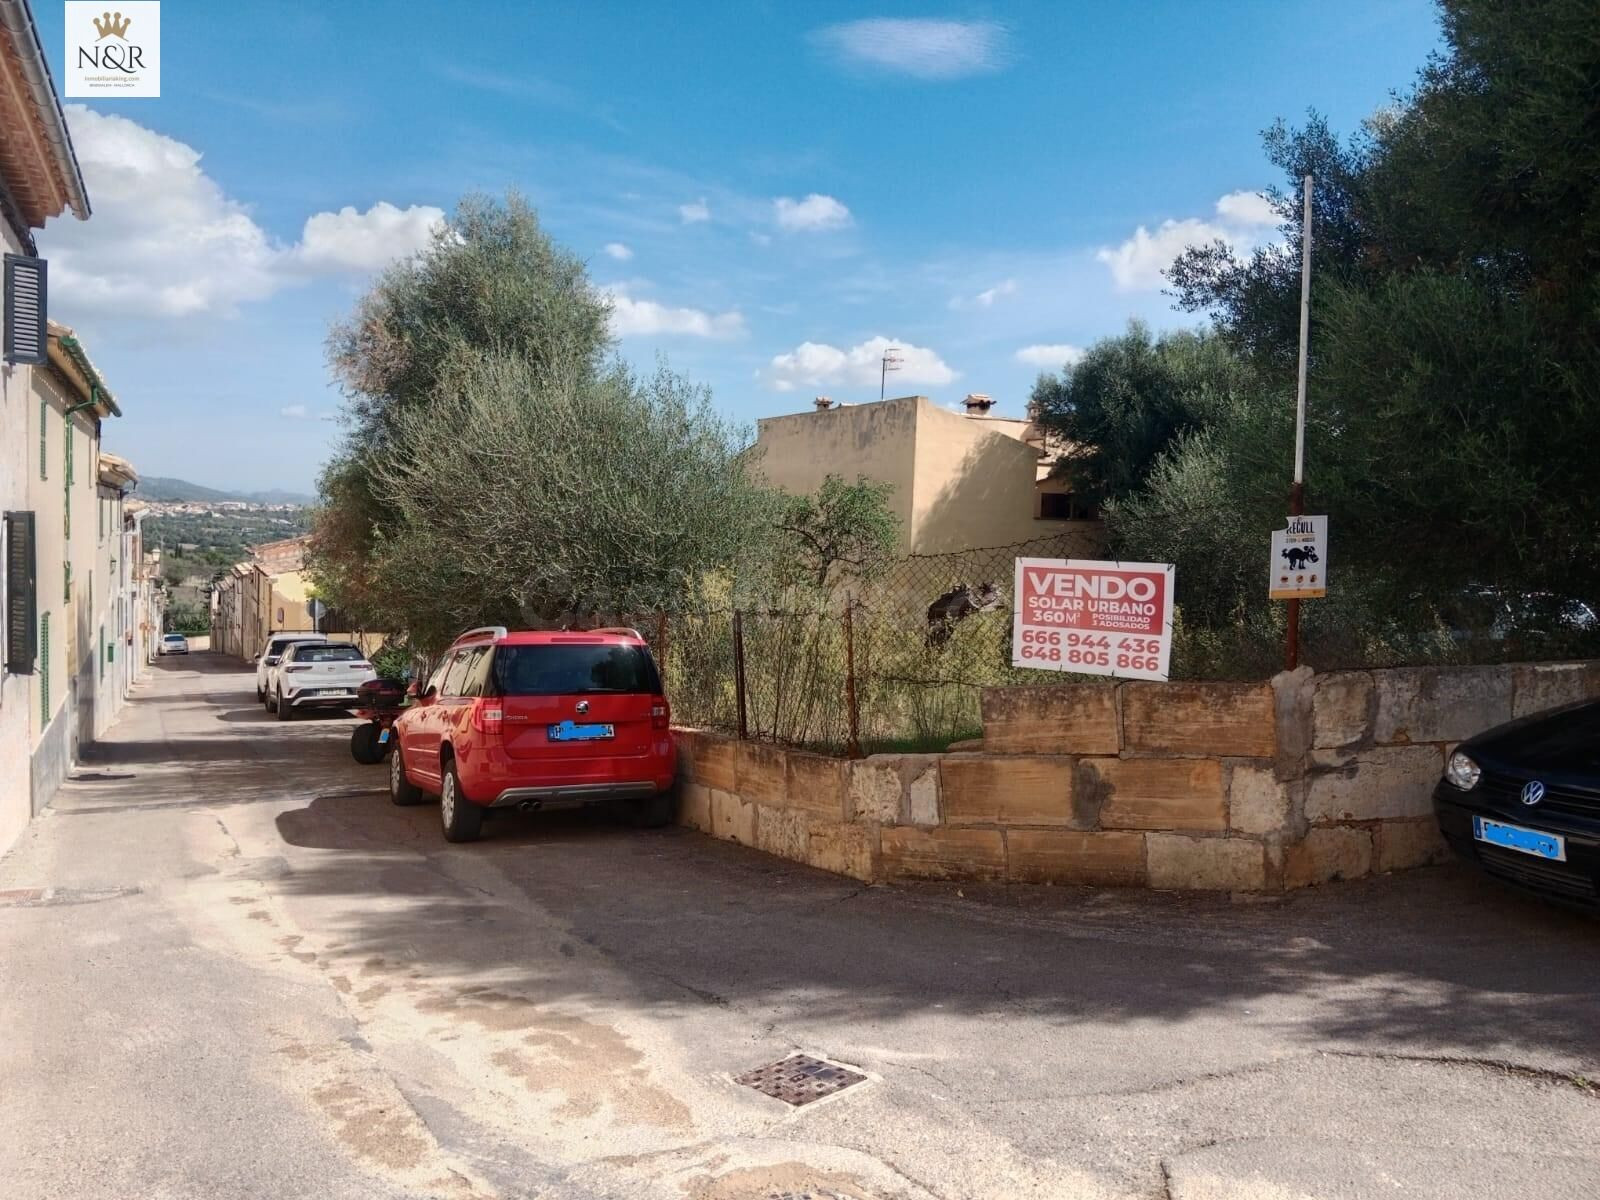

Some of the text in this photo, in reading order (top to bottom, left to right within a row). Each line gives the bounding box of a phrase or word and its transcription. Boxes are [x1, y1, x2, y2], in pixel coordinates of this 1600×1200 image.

[1028, 572, 1156, 602] VENDO
[1028, 597, 1156, 616] SOLAR URBANO
[1092, 613, 1151, 624] POSIBILIDAD
[1099, 621, 1150, 630] ADOSADOS
[1022, 630, 1160, 655] 666 944 436
[1021, 645, 1159, 671] 648 805 866
